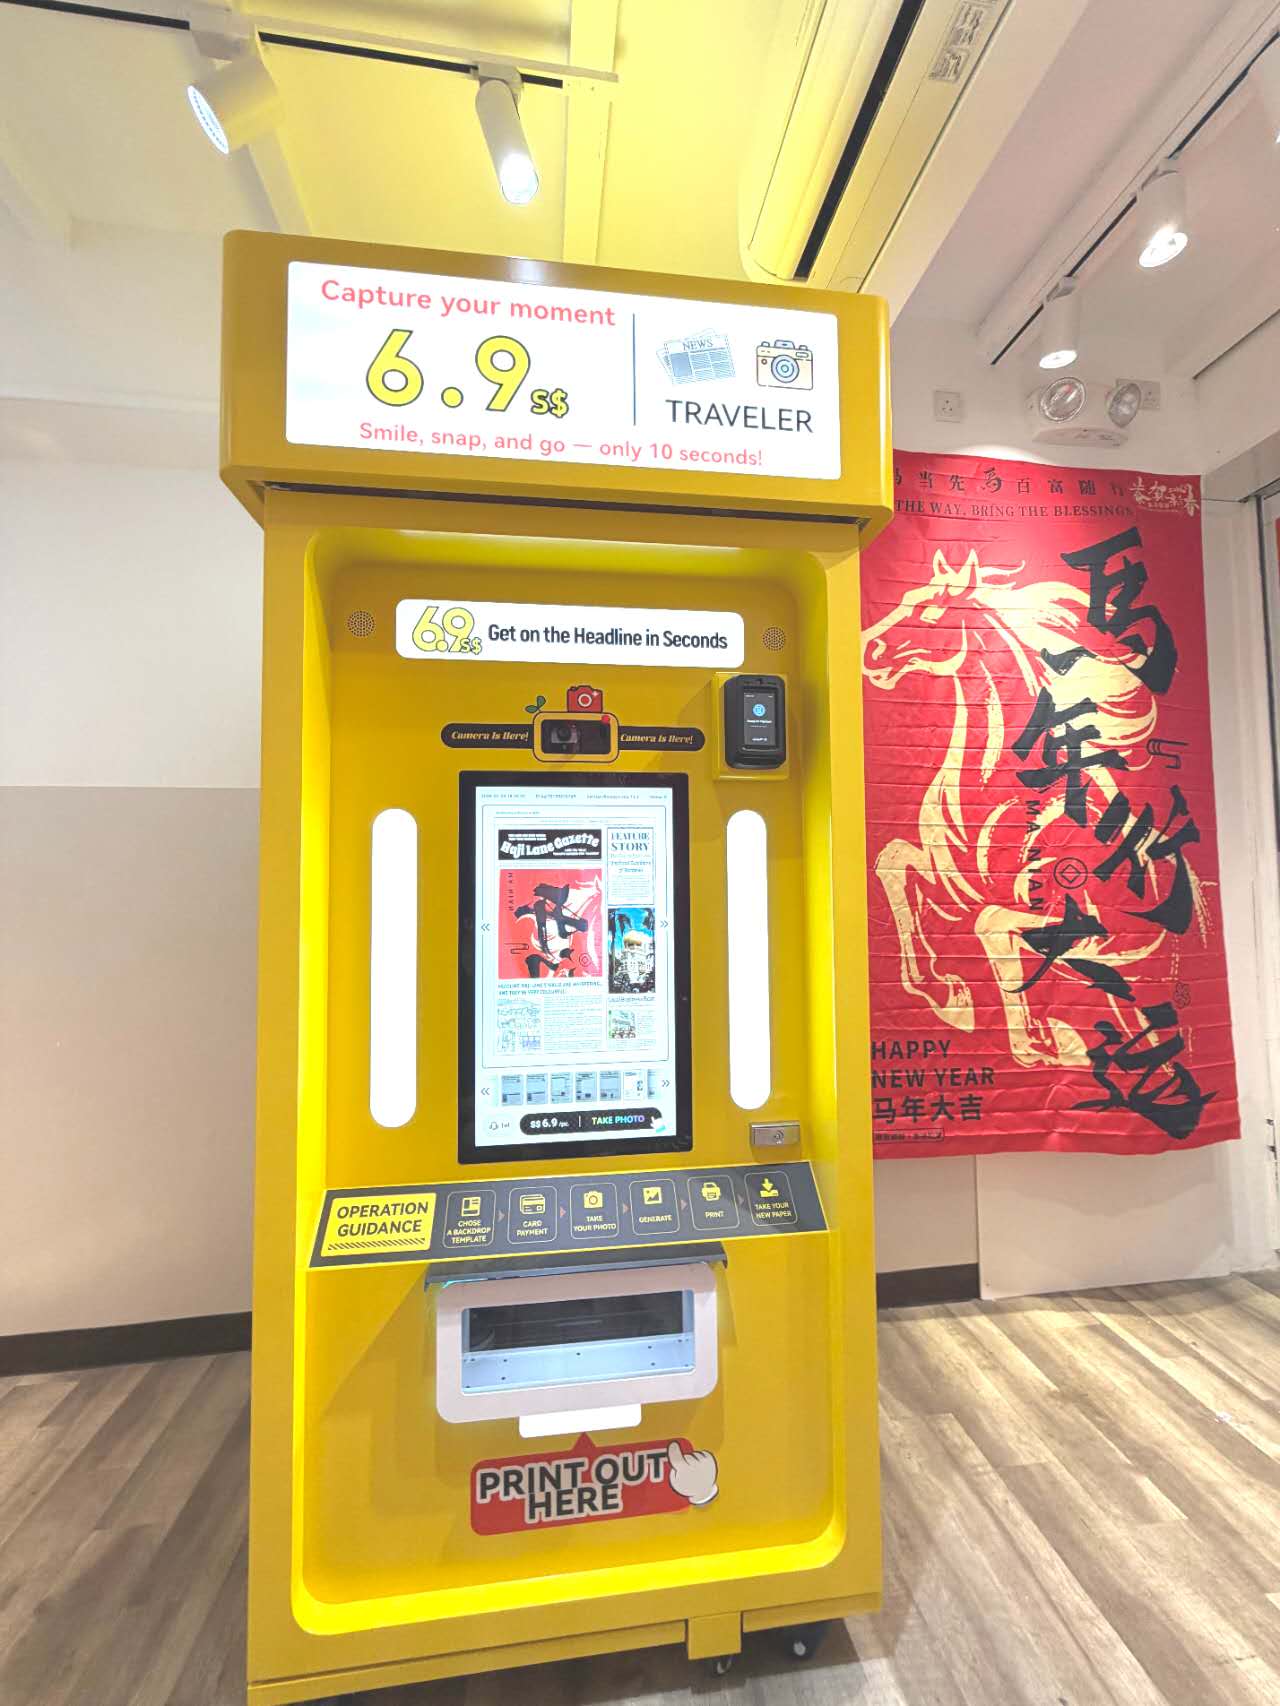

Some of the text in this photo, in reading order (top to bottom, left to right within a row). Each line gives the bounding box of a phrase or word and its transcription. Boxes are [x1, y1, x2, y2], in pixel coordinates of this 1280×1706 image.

[321, 279, 617, 326] Capture your moment
[665, 399, 814, 433] TRAVELER
[359, 421, 424, 447] Smile,
[431, 431, 486, 452] snap,
[492, 431, 533, 452] and
[539, 438, 566, 456] go
[599, 441, 643, 463] only
[650, 443, 673, 461] 10
[679, 446, 764, 466] seconds!
[896, 498, 924, 513] THE
[972, 504, 1014, 518] BRING
[1019, 505, 1048, 518] THE
[488, 623, 517, 642] Get
[520, 626, 541, 644] on
[543, 626, 571, 644] the
[574, 627, 643, 647] Headline
[645, 631, 661, 647] in
[663, 632, 728, 650] Seconds
[451, 731, 529, 742] Camera Is Here!
[620, 733, 694, 745] Camera Is Here!
[1025, 800, 1041, 833] MA
[611, 842, 649, 851] STORY
[871, 1039, 951, 1060] HAPPY
[871, 1067, 995, 1089] NEW YEAR
[872, 1093, 983, 1124] 马年大吉
[542, 1117, 558, 1128] 6.9
[592, 1114, 645, 1125] TAKE PHOTO
[336, 1201, 429, 1219] OPERATION
[639, 1215, 673, 1223] GENERATE
[337, 1219, 422, 1238] GUIDANCE
[516, 1229, 549, 1237] PAYMENT
[523, 1220, 542, 1228] CARD
[593, 1223, 617, 1231] PHOTO
[452, 1236, 487, 1244] TEMPLATE
[479, 1452, 667, 1499] PRINT OUT
[528, 1483, 620, 1519] HERE
